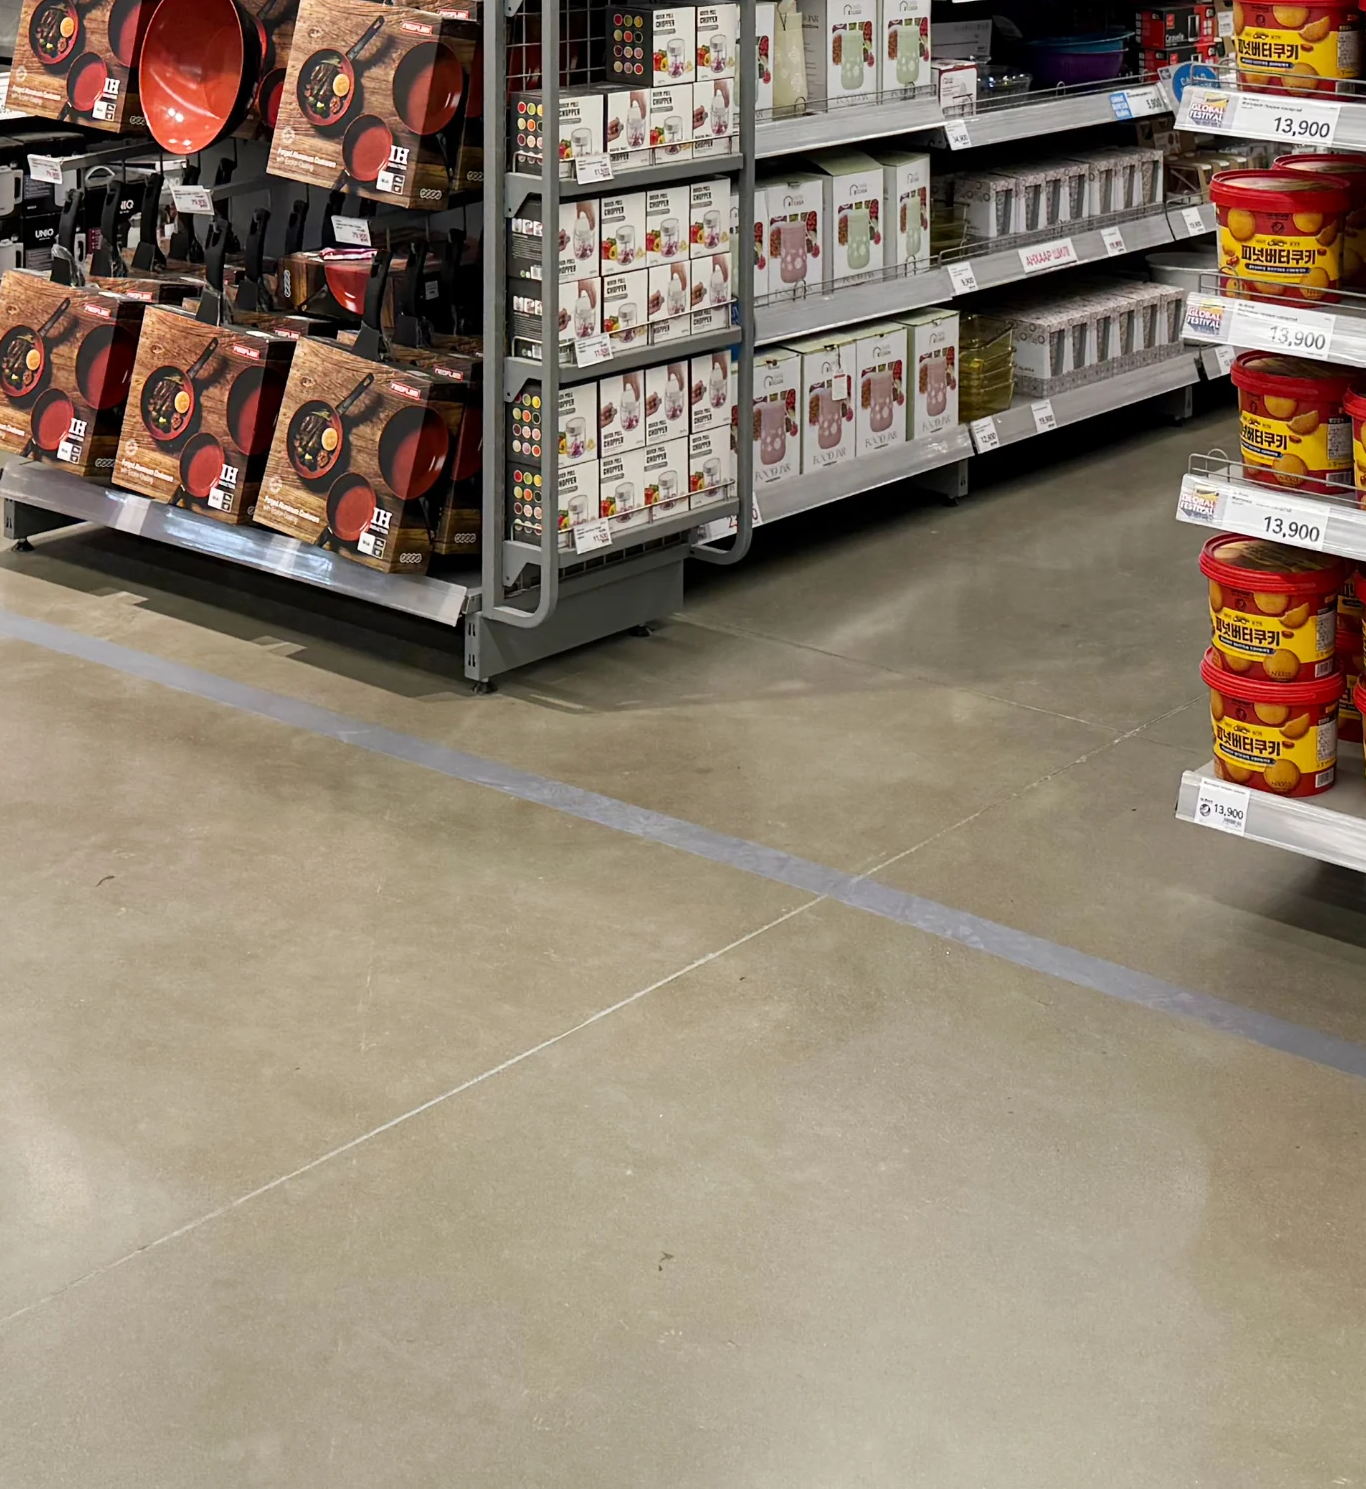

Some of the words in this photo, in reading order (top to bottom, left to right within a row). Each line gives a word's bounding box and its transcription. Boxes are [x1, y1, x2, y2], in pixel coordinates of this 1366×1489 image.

[104, 78, 120, 94] IH
[1273, 115, 1331, 139] 13,900
[389, 145, 410, 164] IH
[1241, 244, 1317, 265] 피넛버터쿠키
[1269, 325, 1326, 351] 13,900
[69, 418, 87, 434] IH
[371, 507, 392, 529] IH
[1263, 516, 1320, 543] 13,900
[1213, 803, 1244, 820] 13,900
